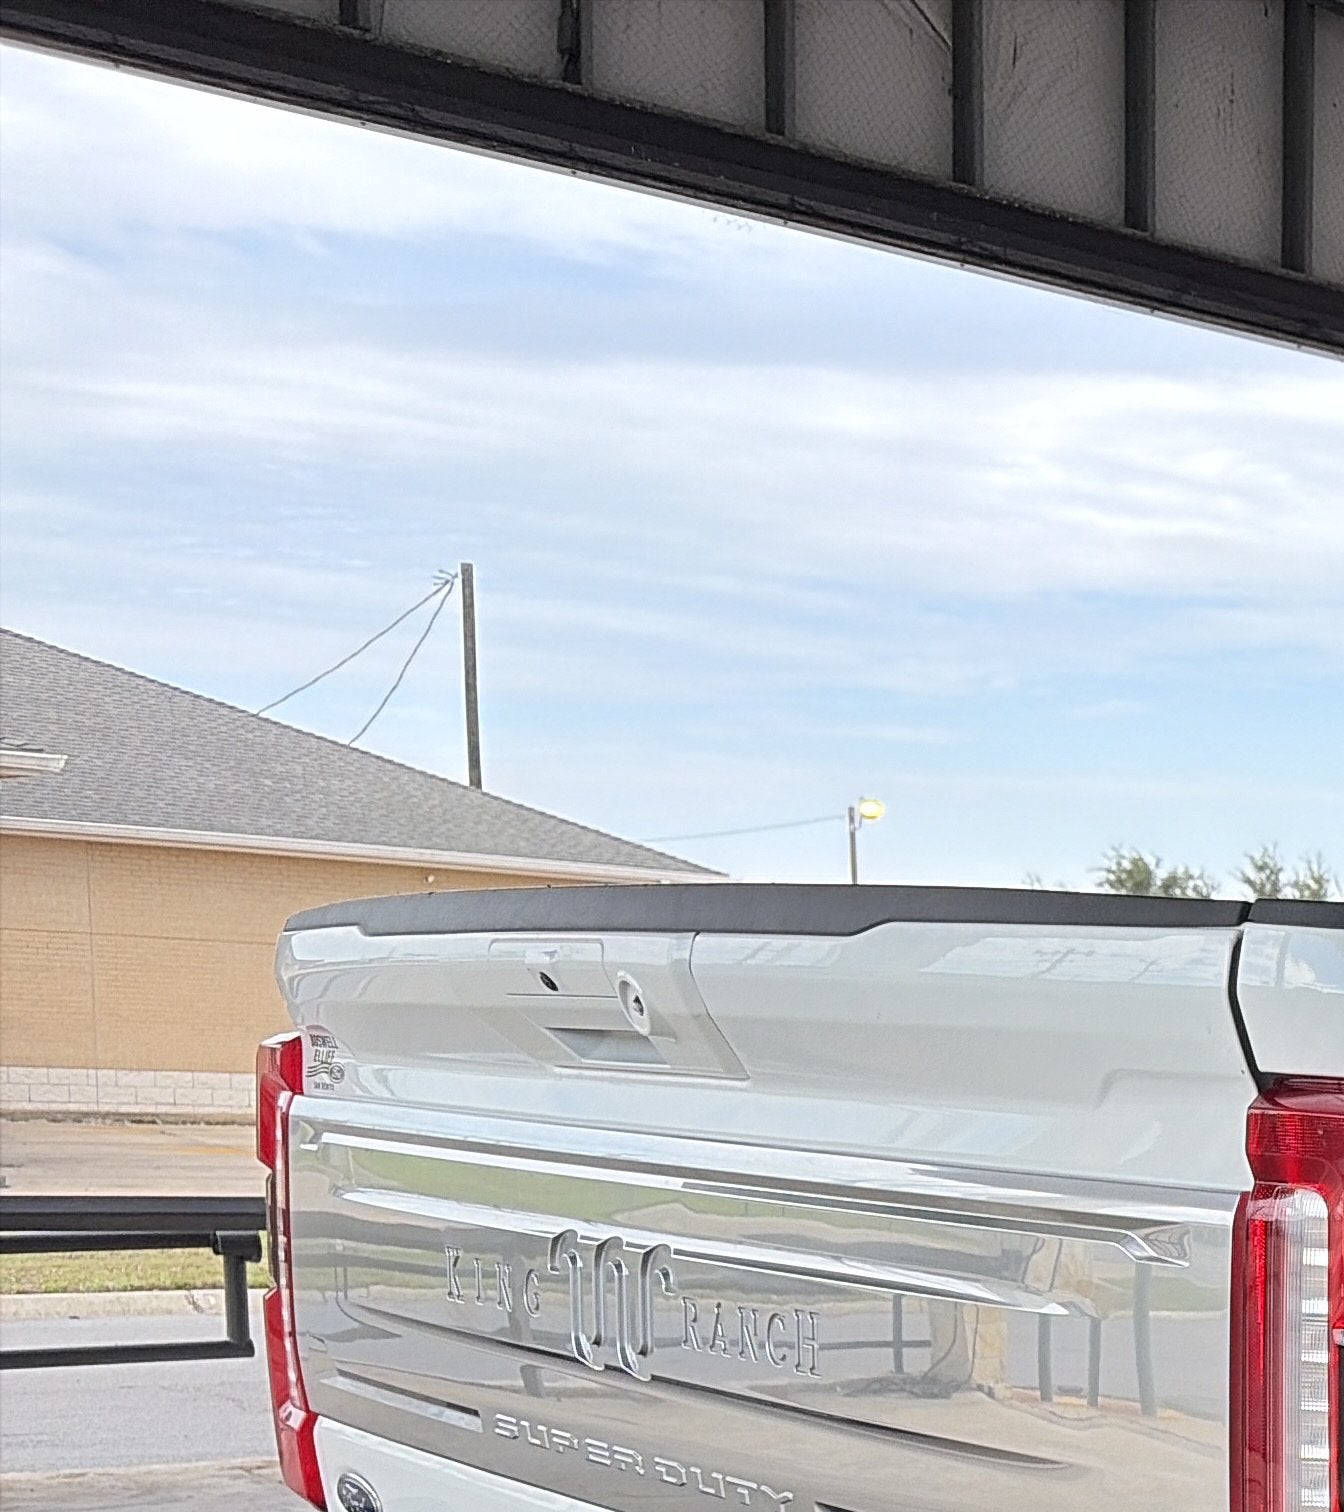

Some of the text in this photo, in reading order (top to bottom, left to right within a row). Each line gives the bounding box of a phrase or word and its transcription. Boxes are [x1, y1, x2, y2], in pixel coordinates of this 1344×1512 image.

[444, 1245, 823, 1379] KING RANCH
[494, 1413, 645, 1476] SUPER
